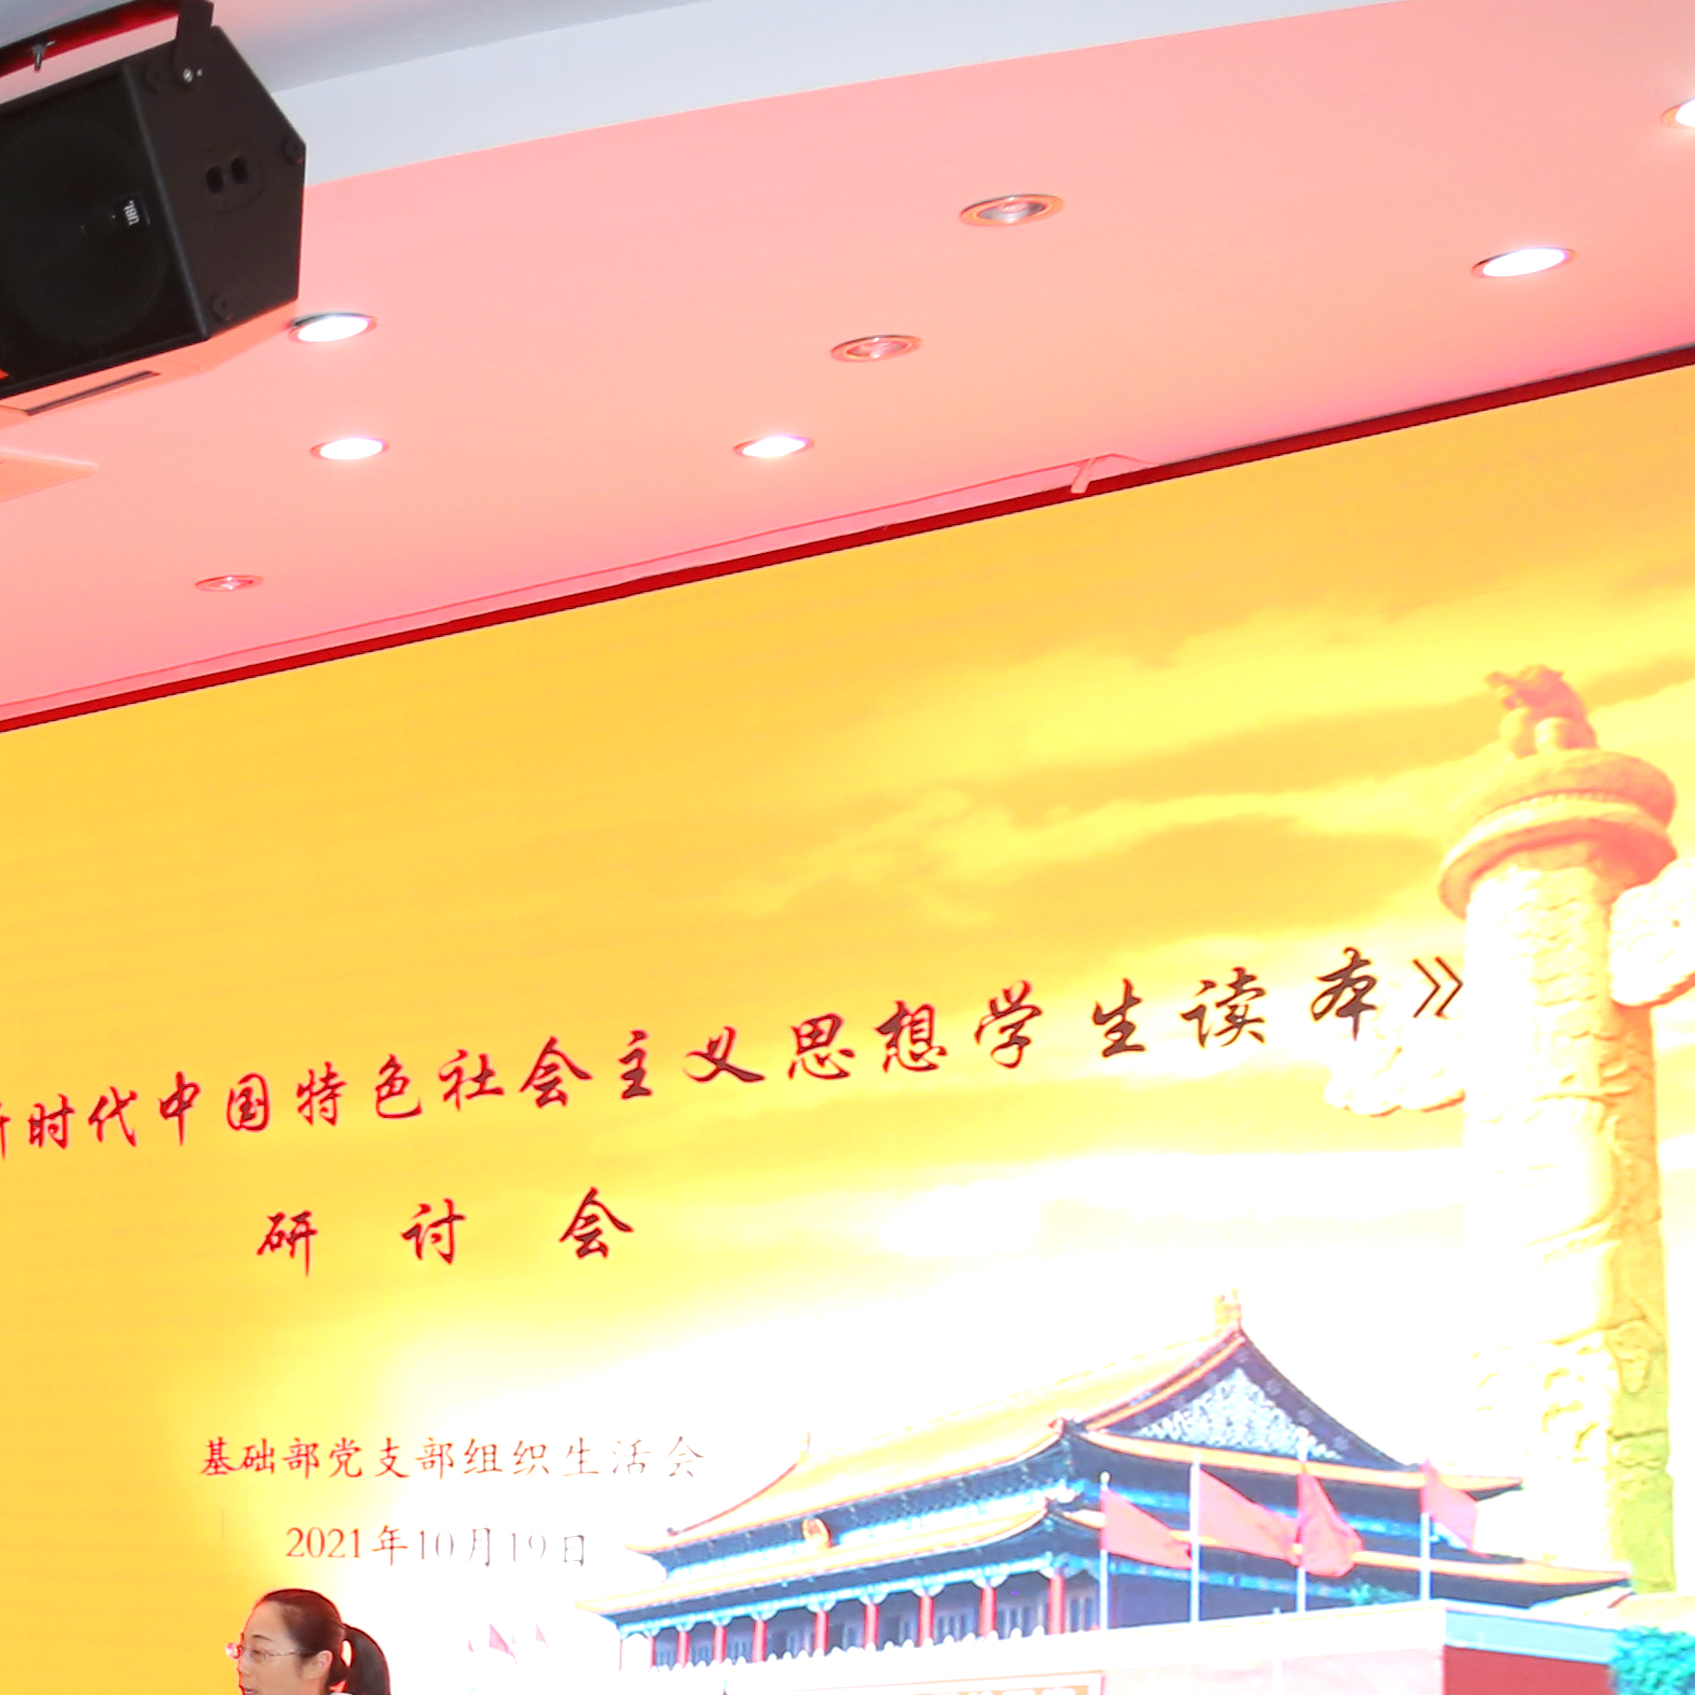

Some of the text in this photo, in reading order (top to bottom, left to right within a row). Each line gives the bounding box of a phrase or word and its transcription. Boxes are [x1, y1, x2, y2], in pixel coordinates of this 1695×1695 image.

[256, 1187, 634, 1276] 研讨会
[199, 1435, 704, 1479] 基础部党支部组织生活会
[286, 1525, 585, 1567] 2021年10月19日
